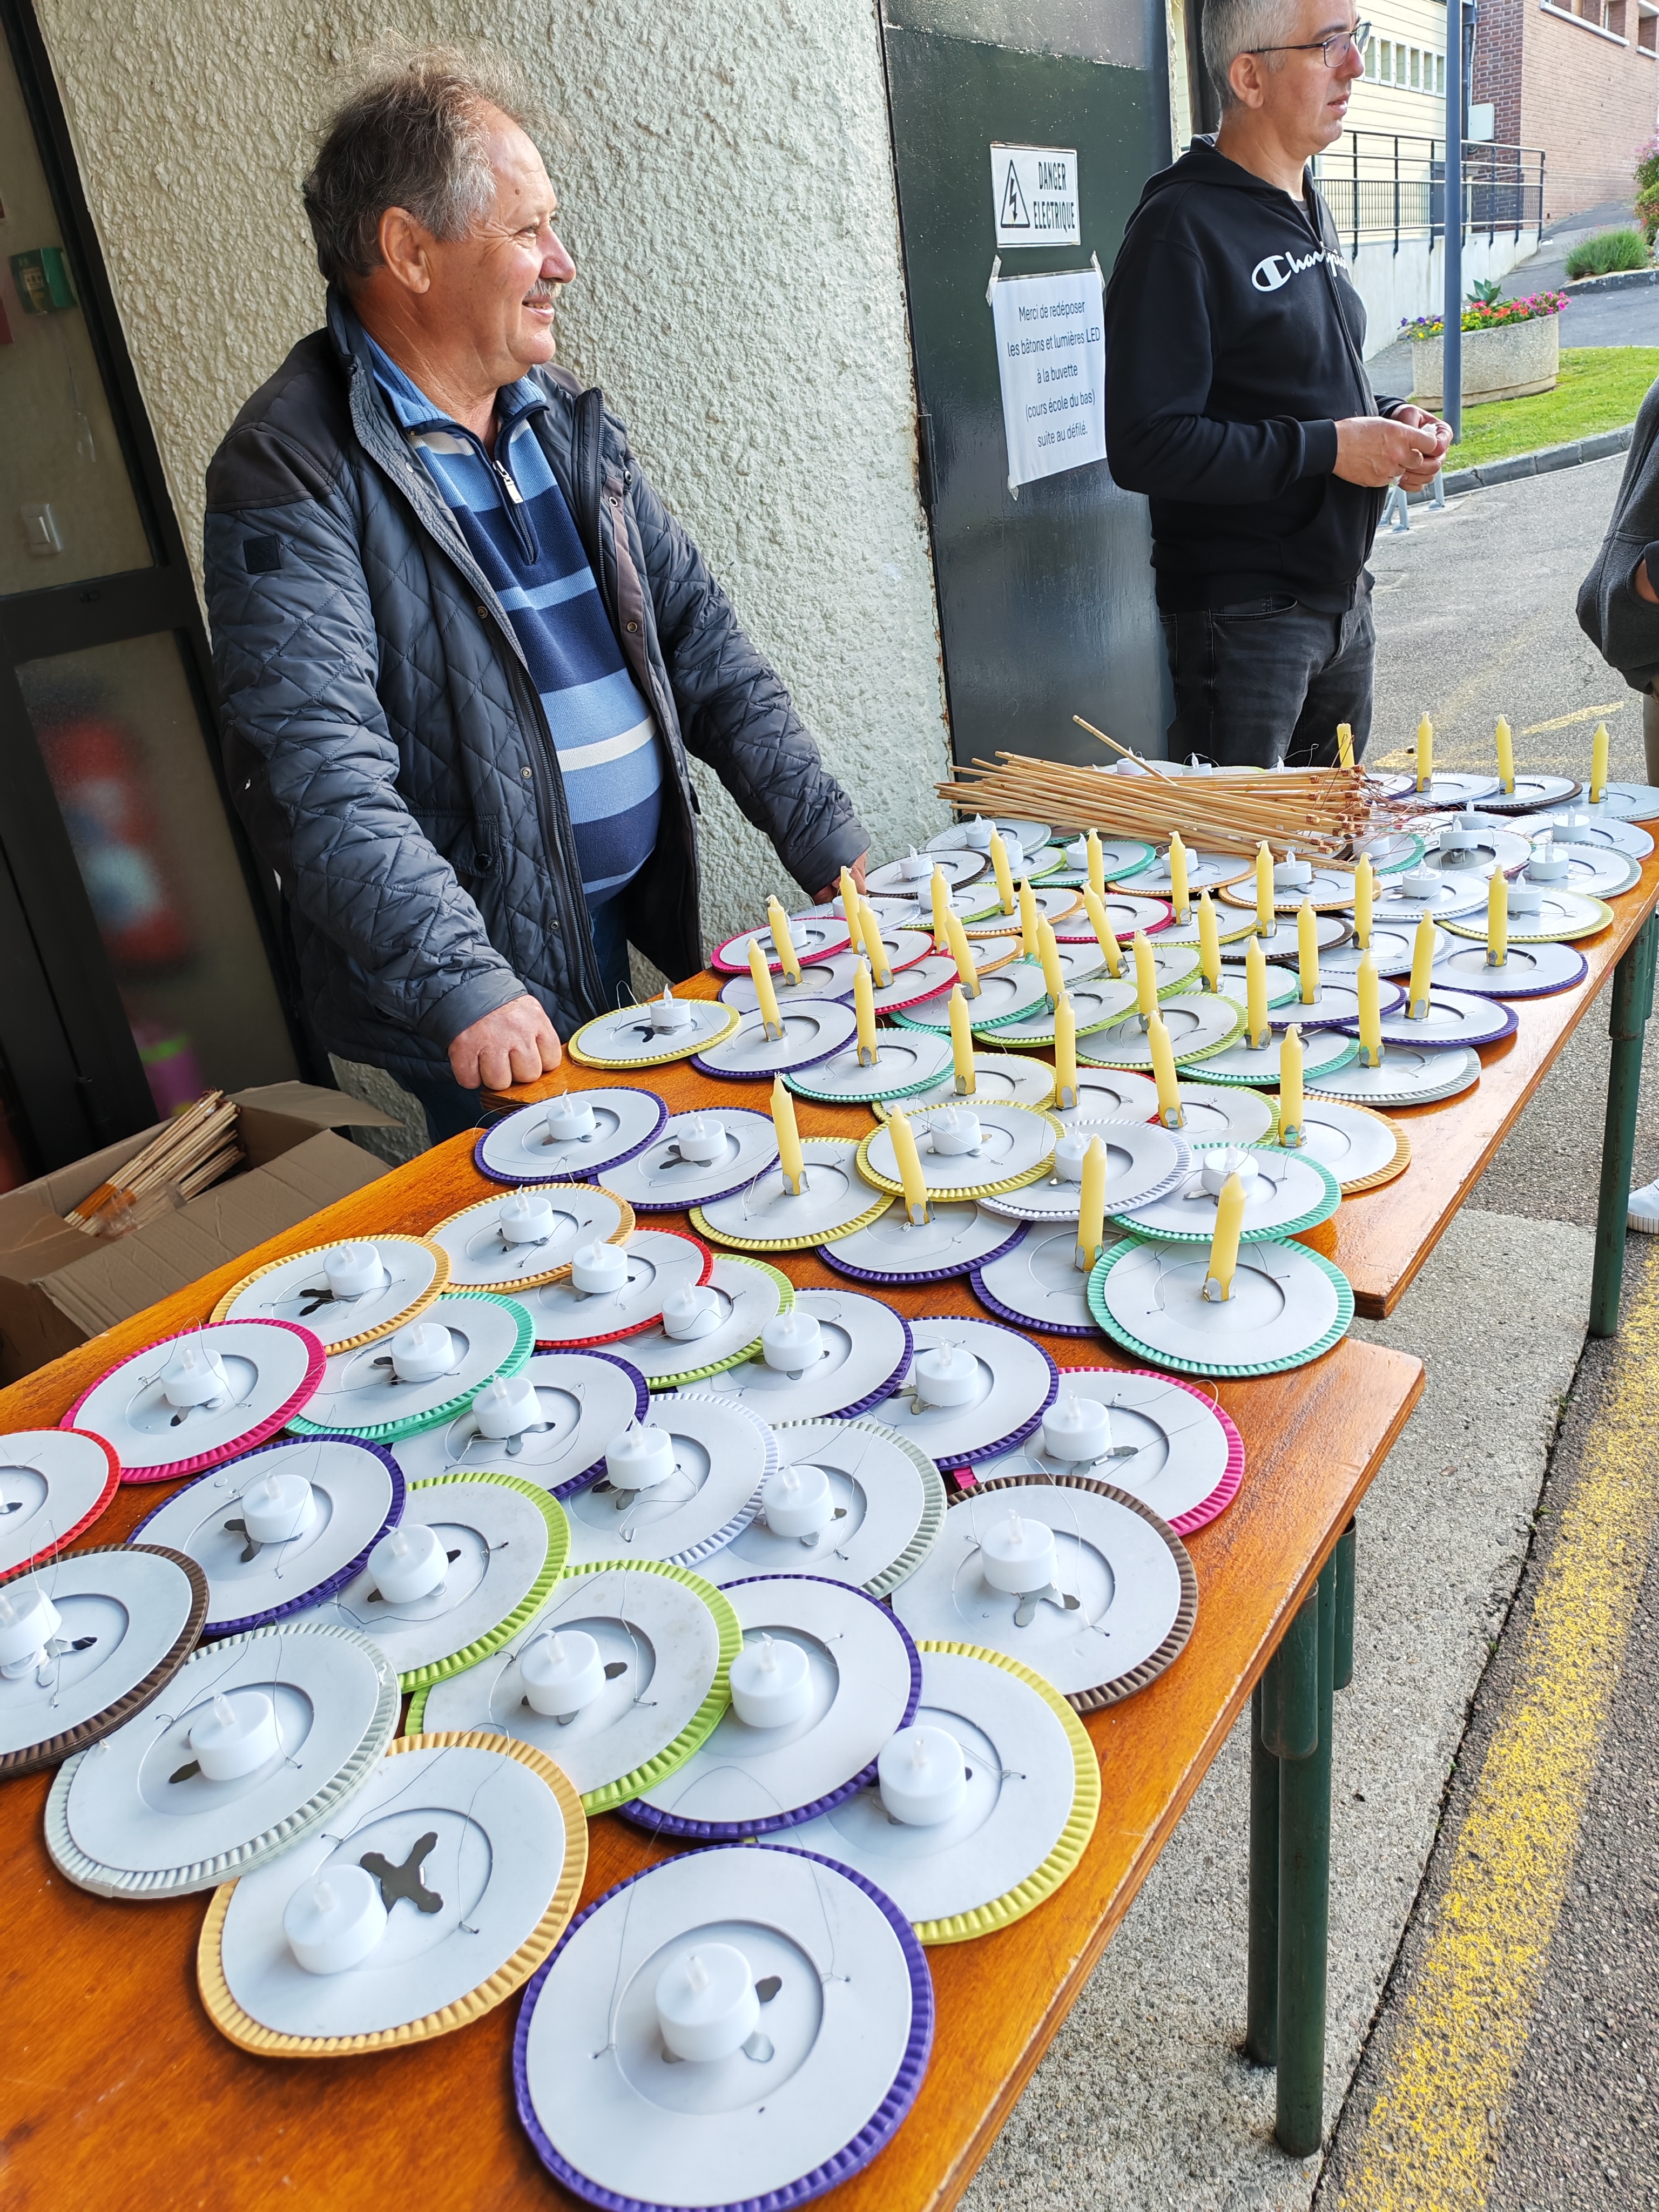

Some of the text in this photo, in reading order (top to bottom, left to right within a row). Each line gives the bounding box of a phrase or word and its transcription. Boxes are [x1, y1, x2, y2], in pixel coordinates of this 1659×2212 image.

[1038, 161, 1067, 191] DANGER
[1033, 201, 1075, 233] ELECTRIQUE
[1019, 300, 1085, 322] Merci de redéposer
[1007, 327, 1101, 357] les bâtons et lumières LED
[1037, 363, 1078, 384] à la buvette
[1026, 388, 1095, 422] (cours école du bas)
[1037, 421, 1088, 448] suite au défilé.
